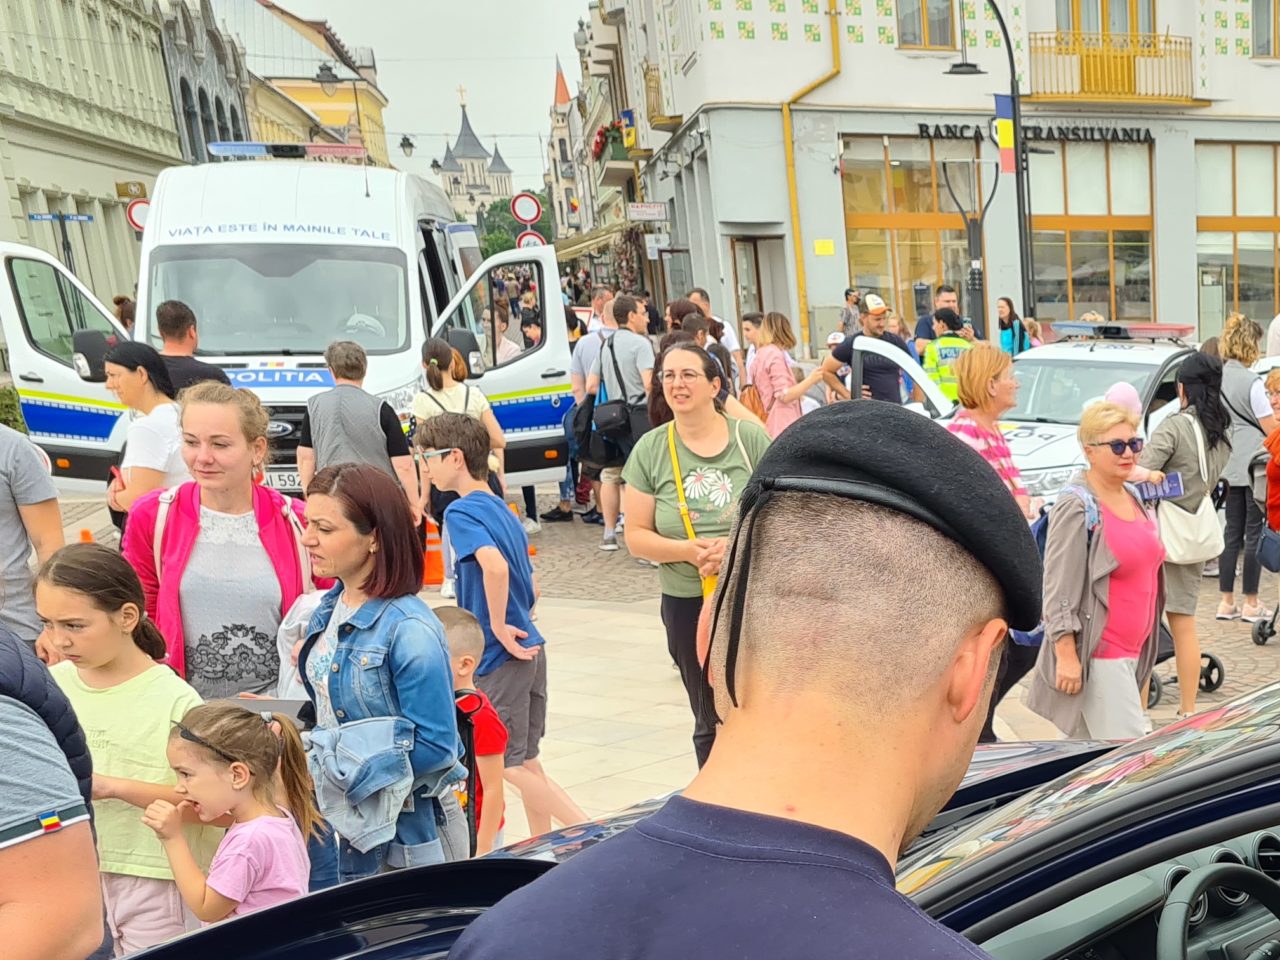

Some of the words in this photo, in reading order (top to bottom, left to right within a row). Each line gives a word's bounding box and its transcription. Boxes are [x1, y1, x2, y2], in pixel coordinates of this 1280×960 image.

[918, 123, 984, 141] BANCA
[1021, 125, 1156, 143] TRANSILVANIA
[218, 223, 258, 233] ESTE
[262, 221, 278, 232] ÎN
[351, 228, 391, 241] TALE
